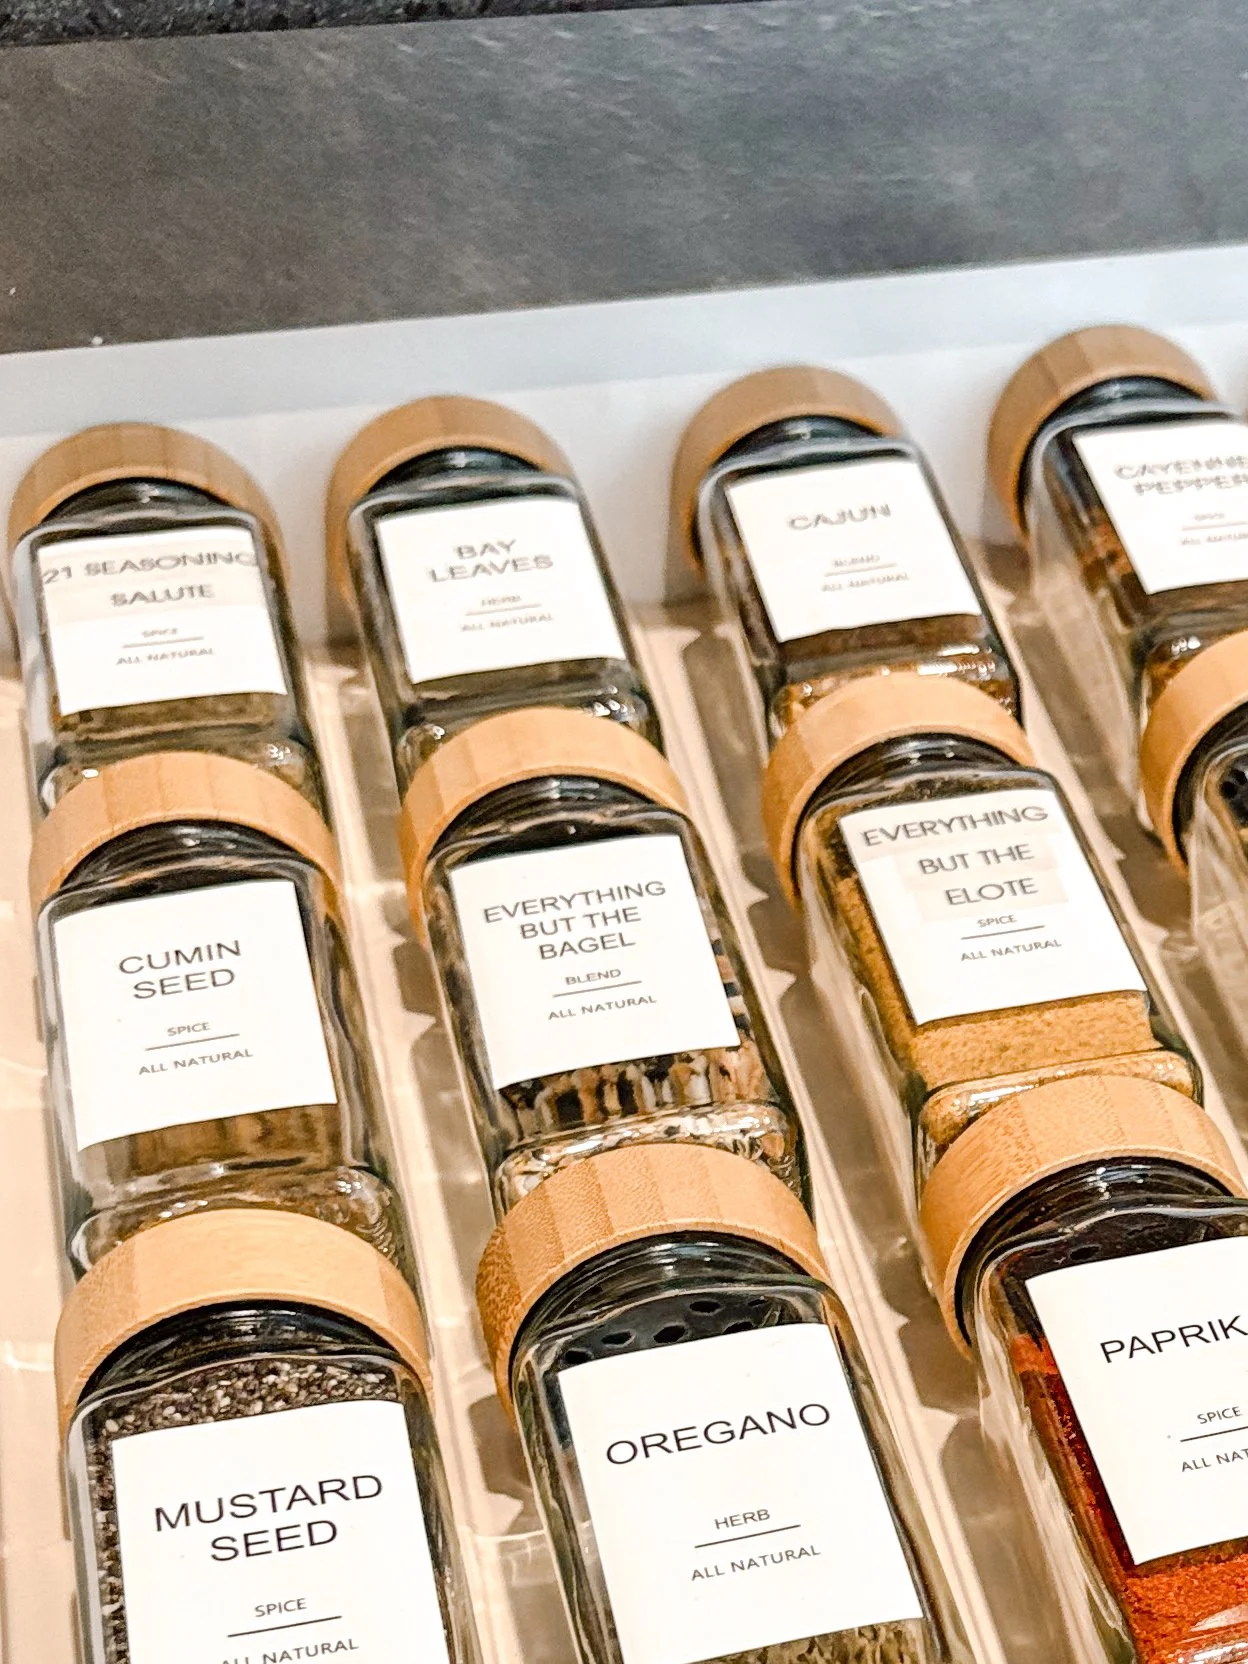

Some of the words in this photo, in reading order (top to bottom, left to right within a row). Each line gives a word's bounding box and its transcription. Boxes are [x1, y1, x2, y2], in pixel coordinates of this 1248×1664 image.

[788, 504, 891, 530] CAJUN
[457, 539, 516, 559] BAY
[42, 566, 73, 584] 21
[428, 554, 554, 583] LEAVES
[111, 583, 215, 607] SALUTE
[862, 806, 1049, 847] EVERYTHING
[918, 852, 969, 875] BUT
[977, 843, 1035, 868] THE
[483, 880, 666, 924] EVERYTHING
[944, 877, 1039, 906] ELOTE
[520, 917, 577, 939] BUT
[583, 906, 642, 929] THE
[977, 914, 1018, 928] SPICE
[118, 940, 241, 974] CUMIN
[538, 932, 636, 960] BAGEL
[960, 950, 987, 962] ALL
[990, 939, 1062, 958] NATURAL
[133, 968, 235, 999] SEED
[565, 968, 622, 986] BLEND
[548, 1008, 577, 1021] ALL
[581, 995, 657, 1015] NATURAL
[166, 1022, 211, 1037] SPICE
[138, 1063, 168, 1076] ALL
[173, 1049, 254, 1069] NATURAL
[1197, 1406, 1243, 1425] SPICE
[606, 1403, 831, 1465] OREGANO
[1181, 1458, 1212, 1473] ALL
[154, 1474, 382, 1532] MUSTARD
[714, 1508, 771, 1530] HERB
[210, 1519, 338, 1562] SEED
[691, 1564, 726, 1581] ALL
[730, 1544, 822, 1573] NATURAL
[254, 1597, 308, 1618] SPICE
